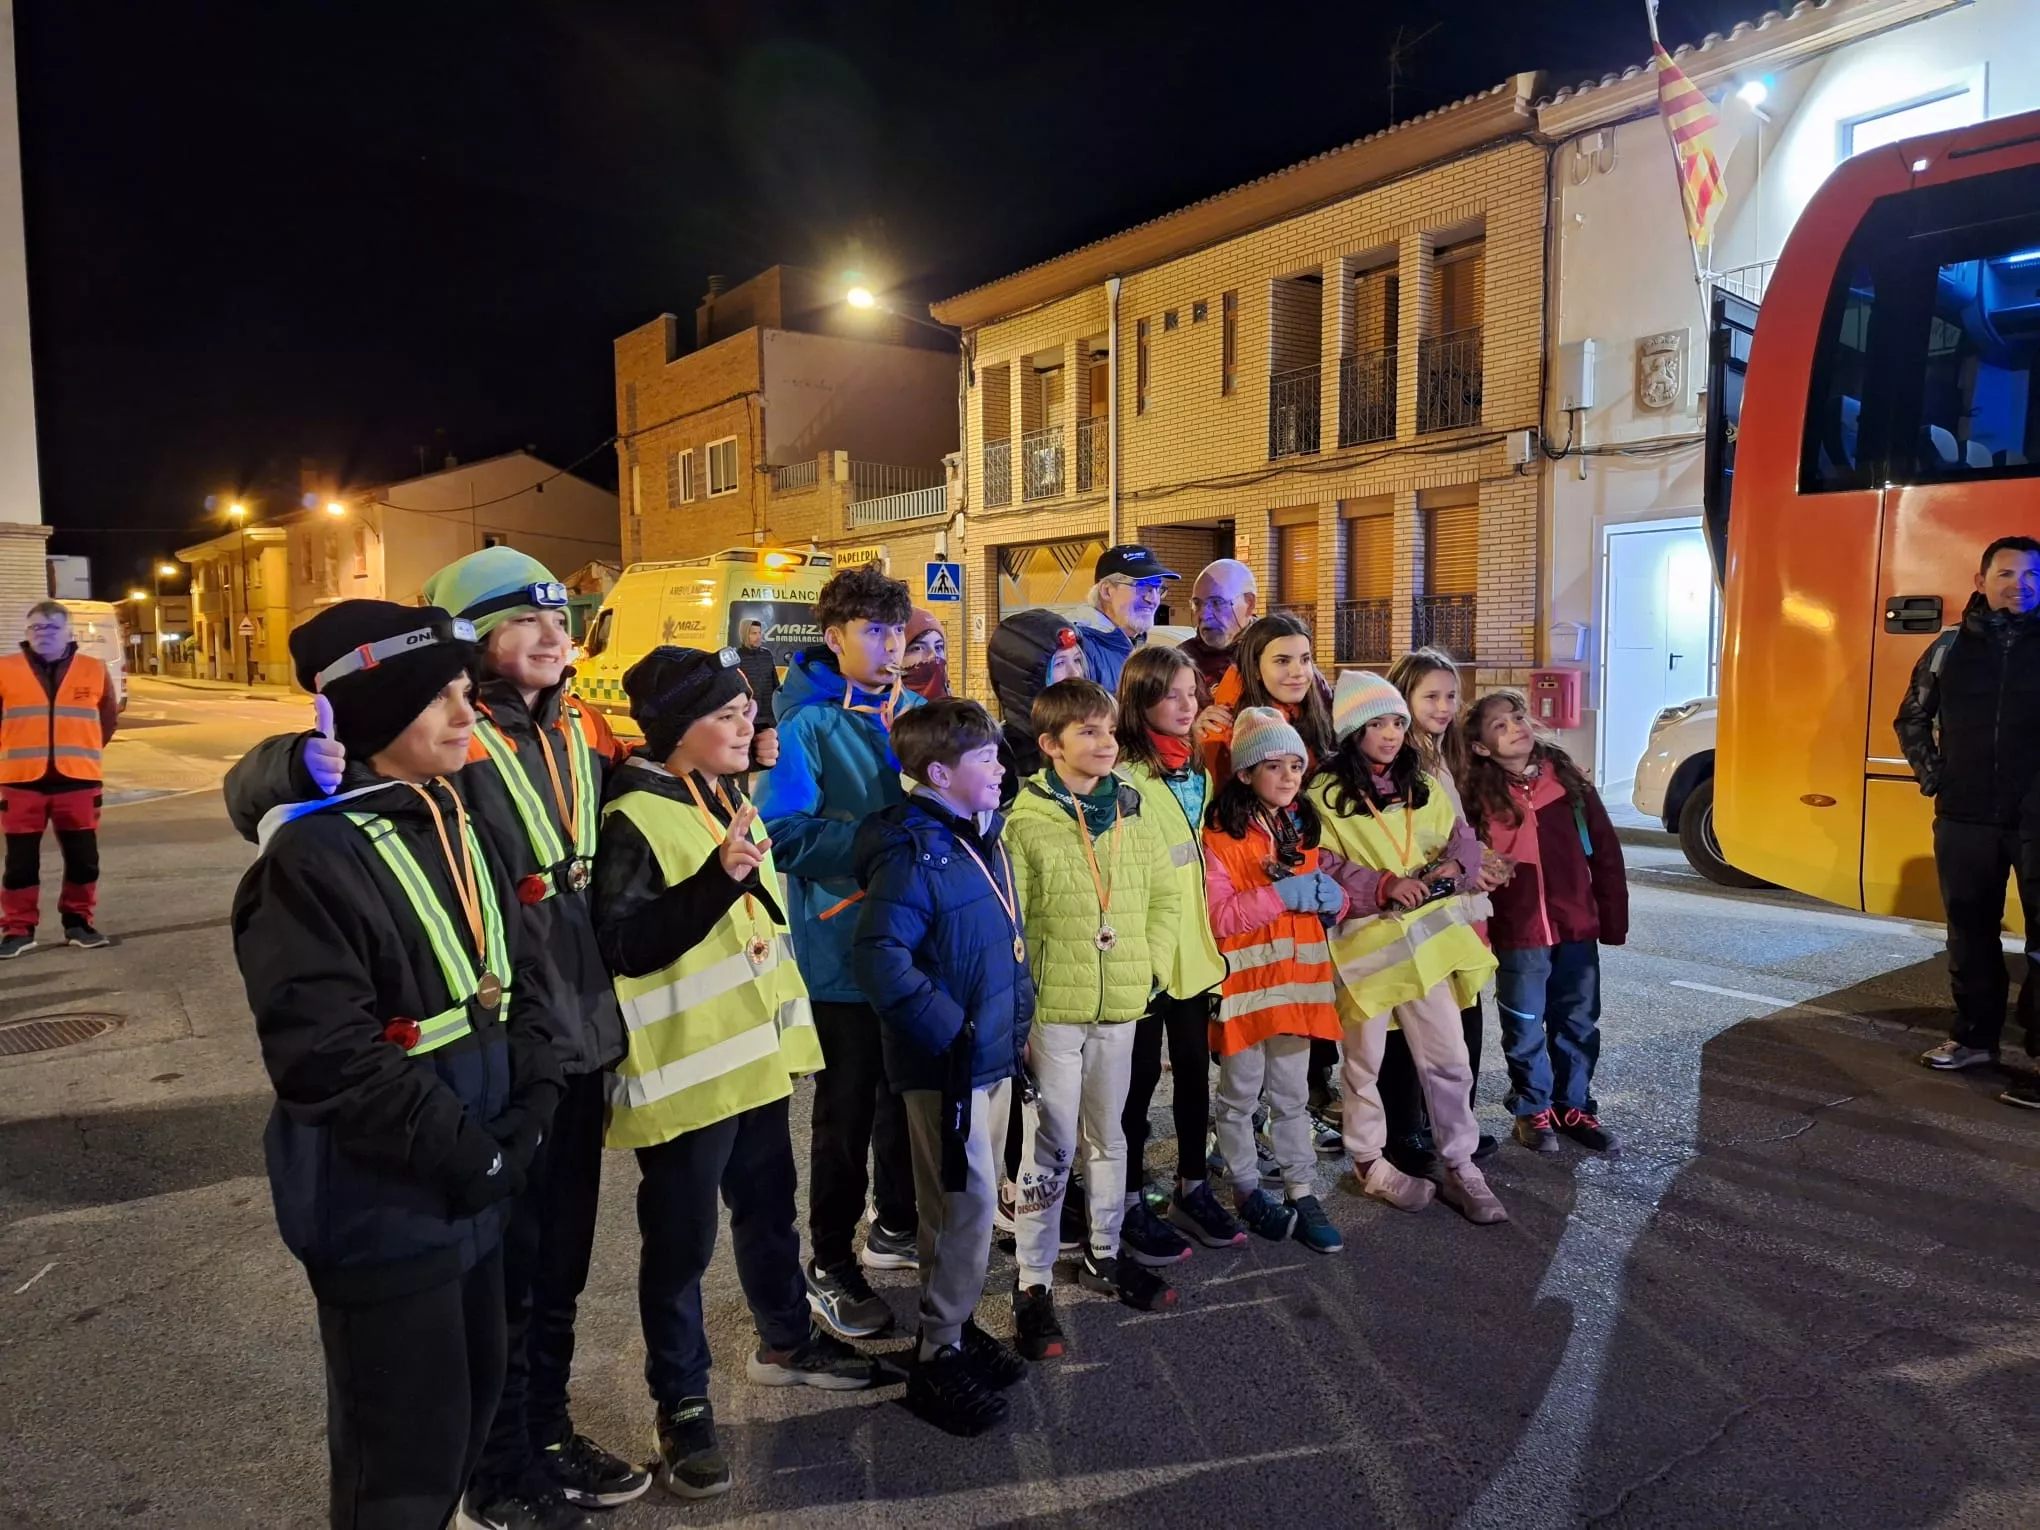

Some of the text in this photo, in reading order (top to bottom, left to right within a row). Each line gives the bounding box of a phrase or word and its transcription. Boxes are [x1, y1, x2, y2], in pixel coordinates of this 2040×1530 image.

[837, 550, 879, 564] PAPELERIA
[740, 587, 820, 601] AMBULANCI
[406, 631, 434, 645] ON
[1023, 1181, 1058, 1203] WILD
